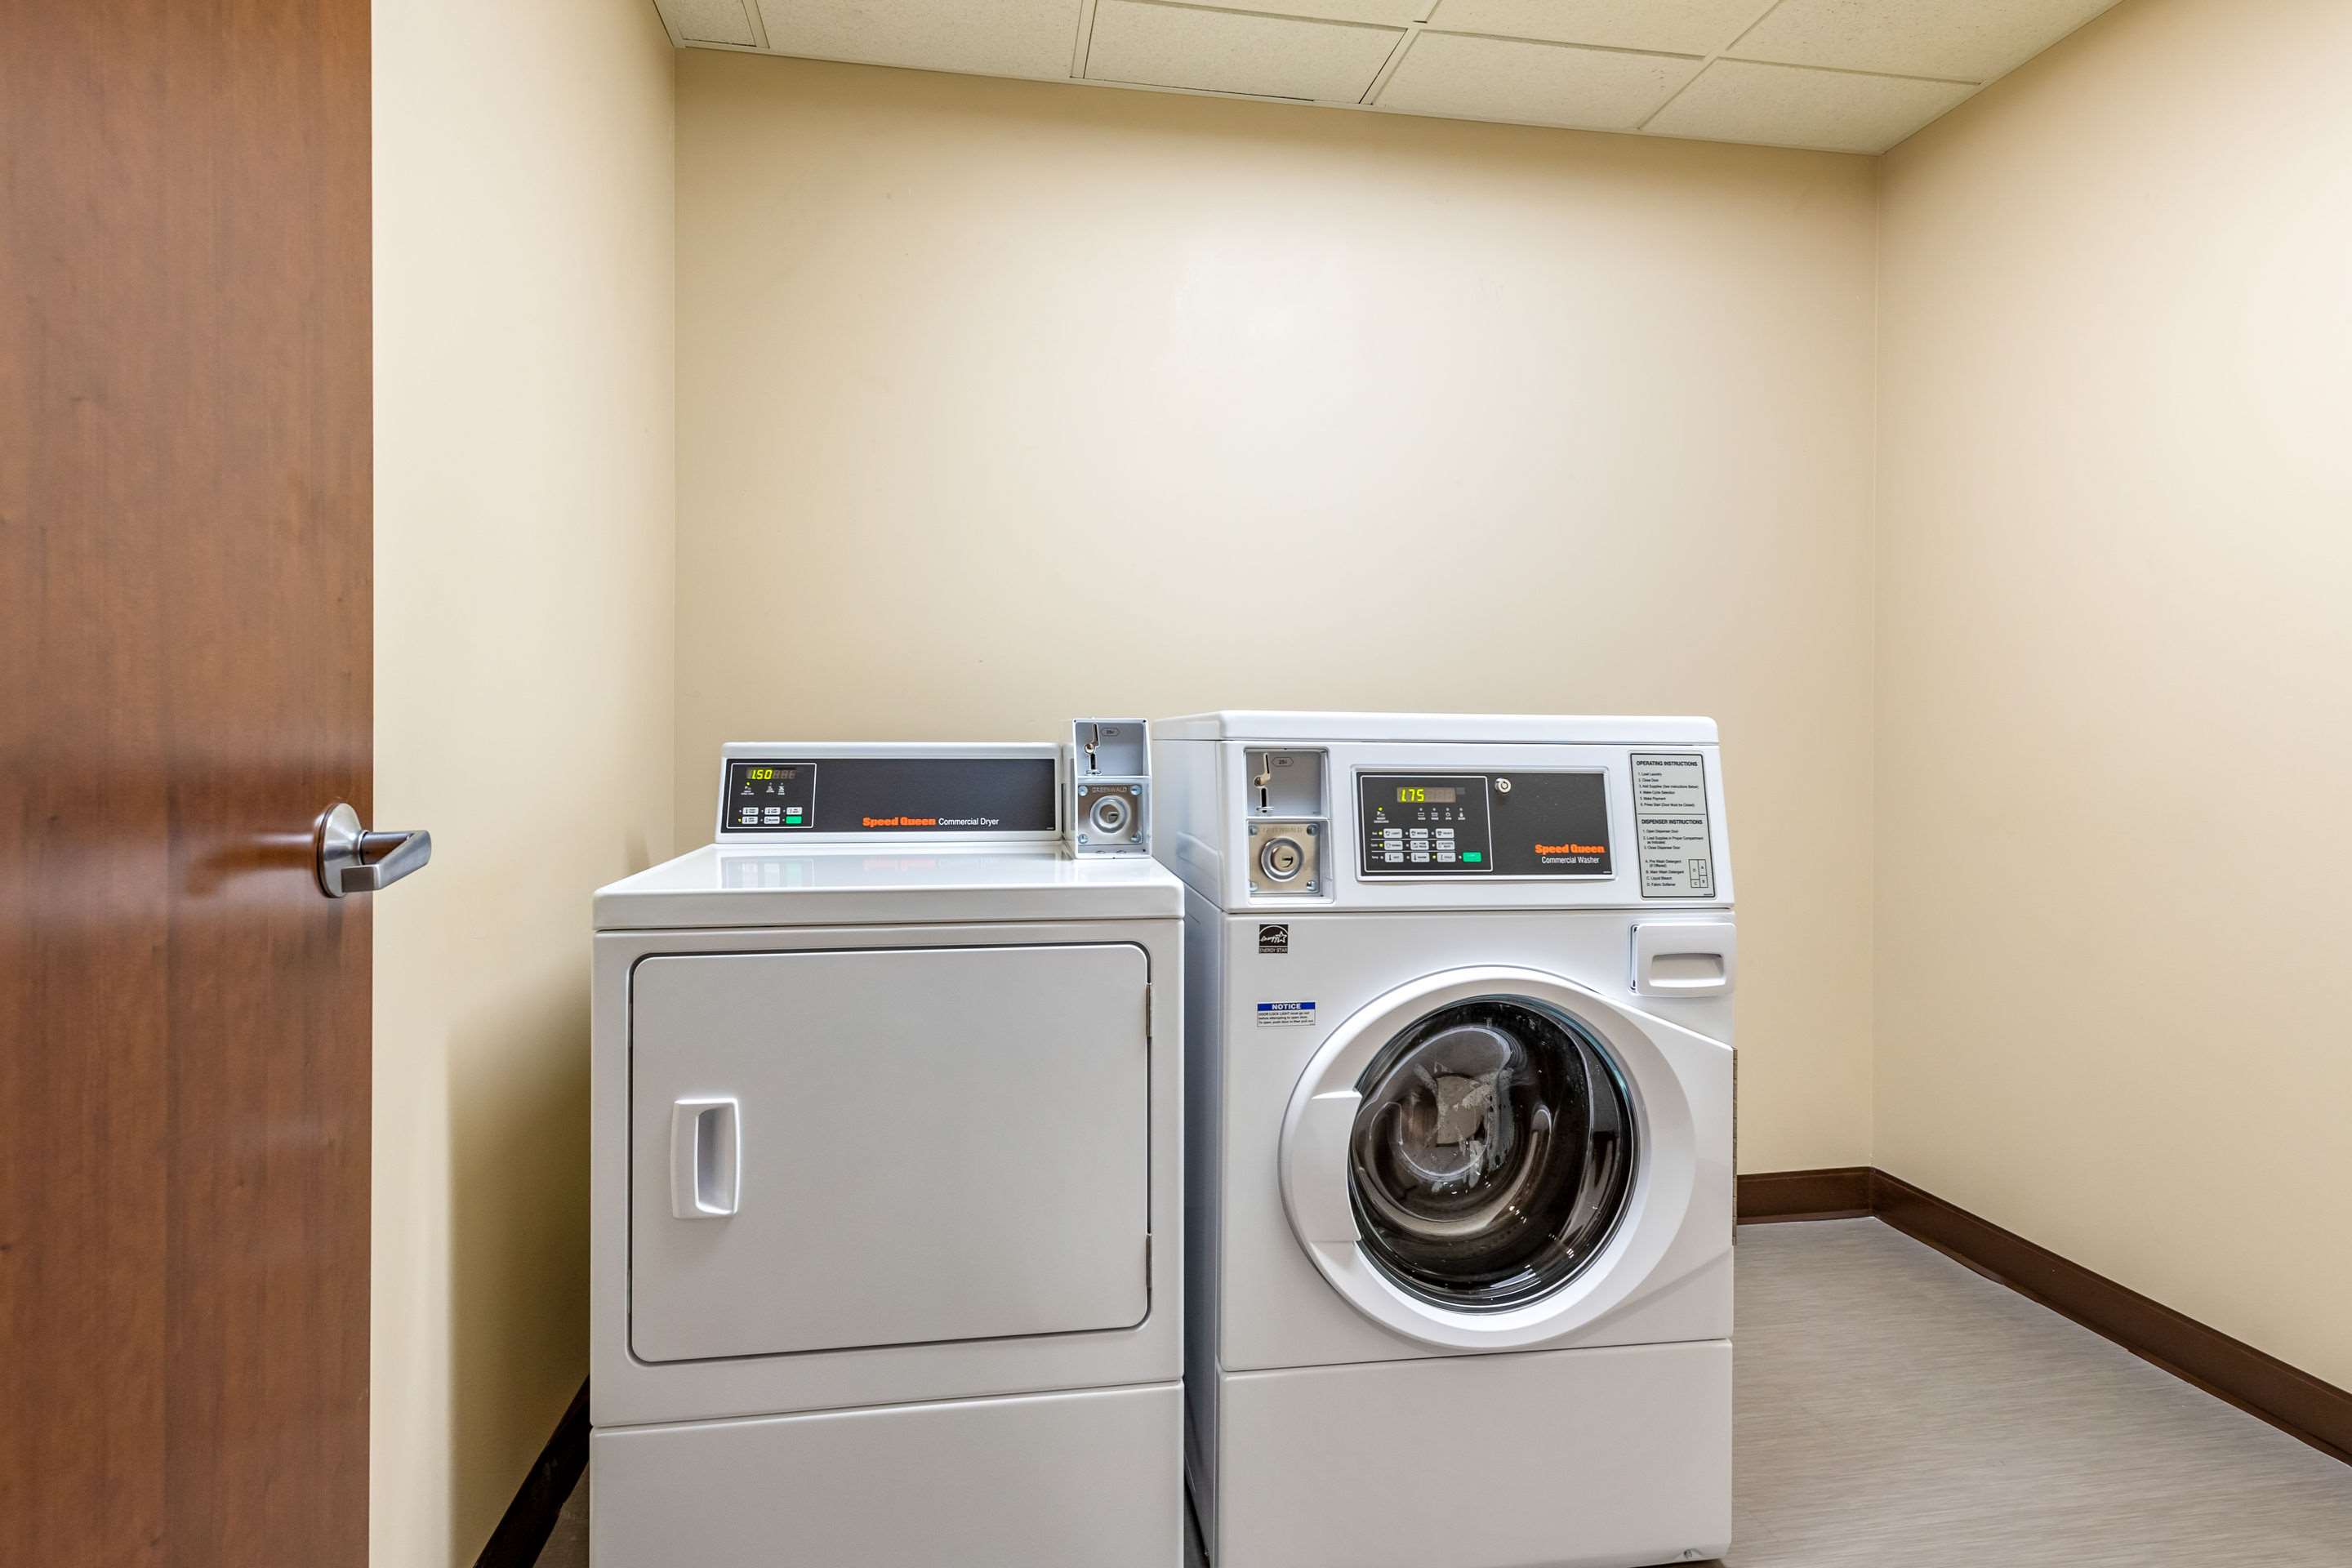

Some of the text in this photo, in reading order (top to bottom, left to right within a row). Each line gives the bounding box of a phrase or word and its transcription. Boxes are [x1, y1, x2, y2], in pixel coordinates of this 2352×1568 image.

[862, 817, 899, 828] Speed
[900, 817, 936, 825] Queen
[980, 818, 999, 827] Dryer
[1535, 844, 1605, 855] Speed Queen
